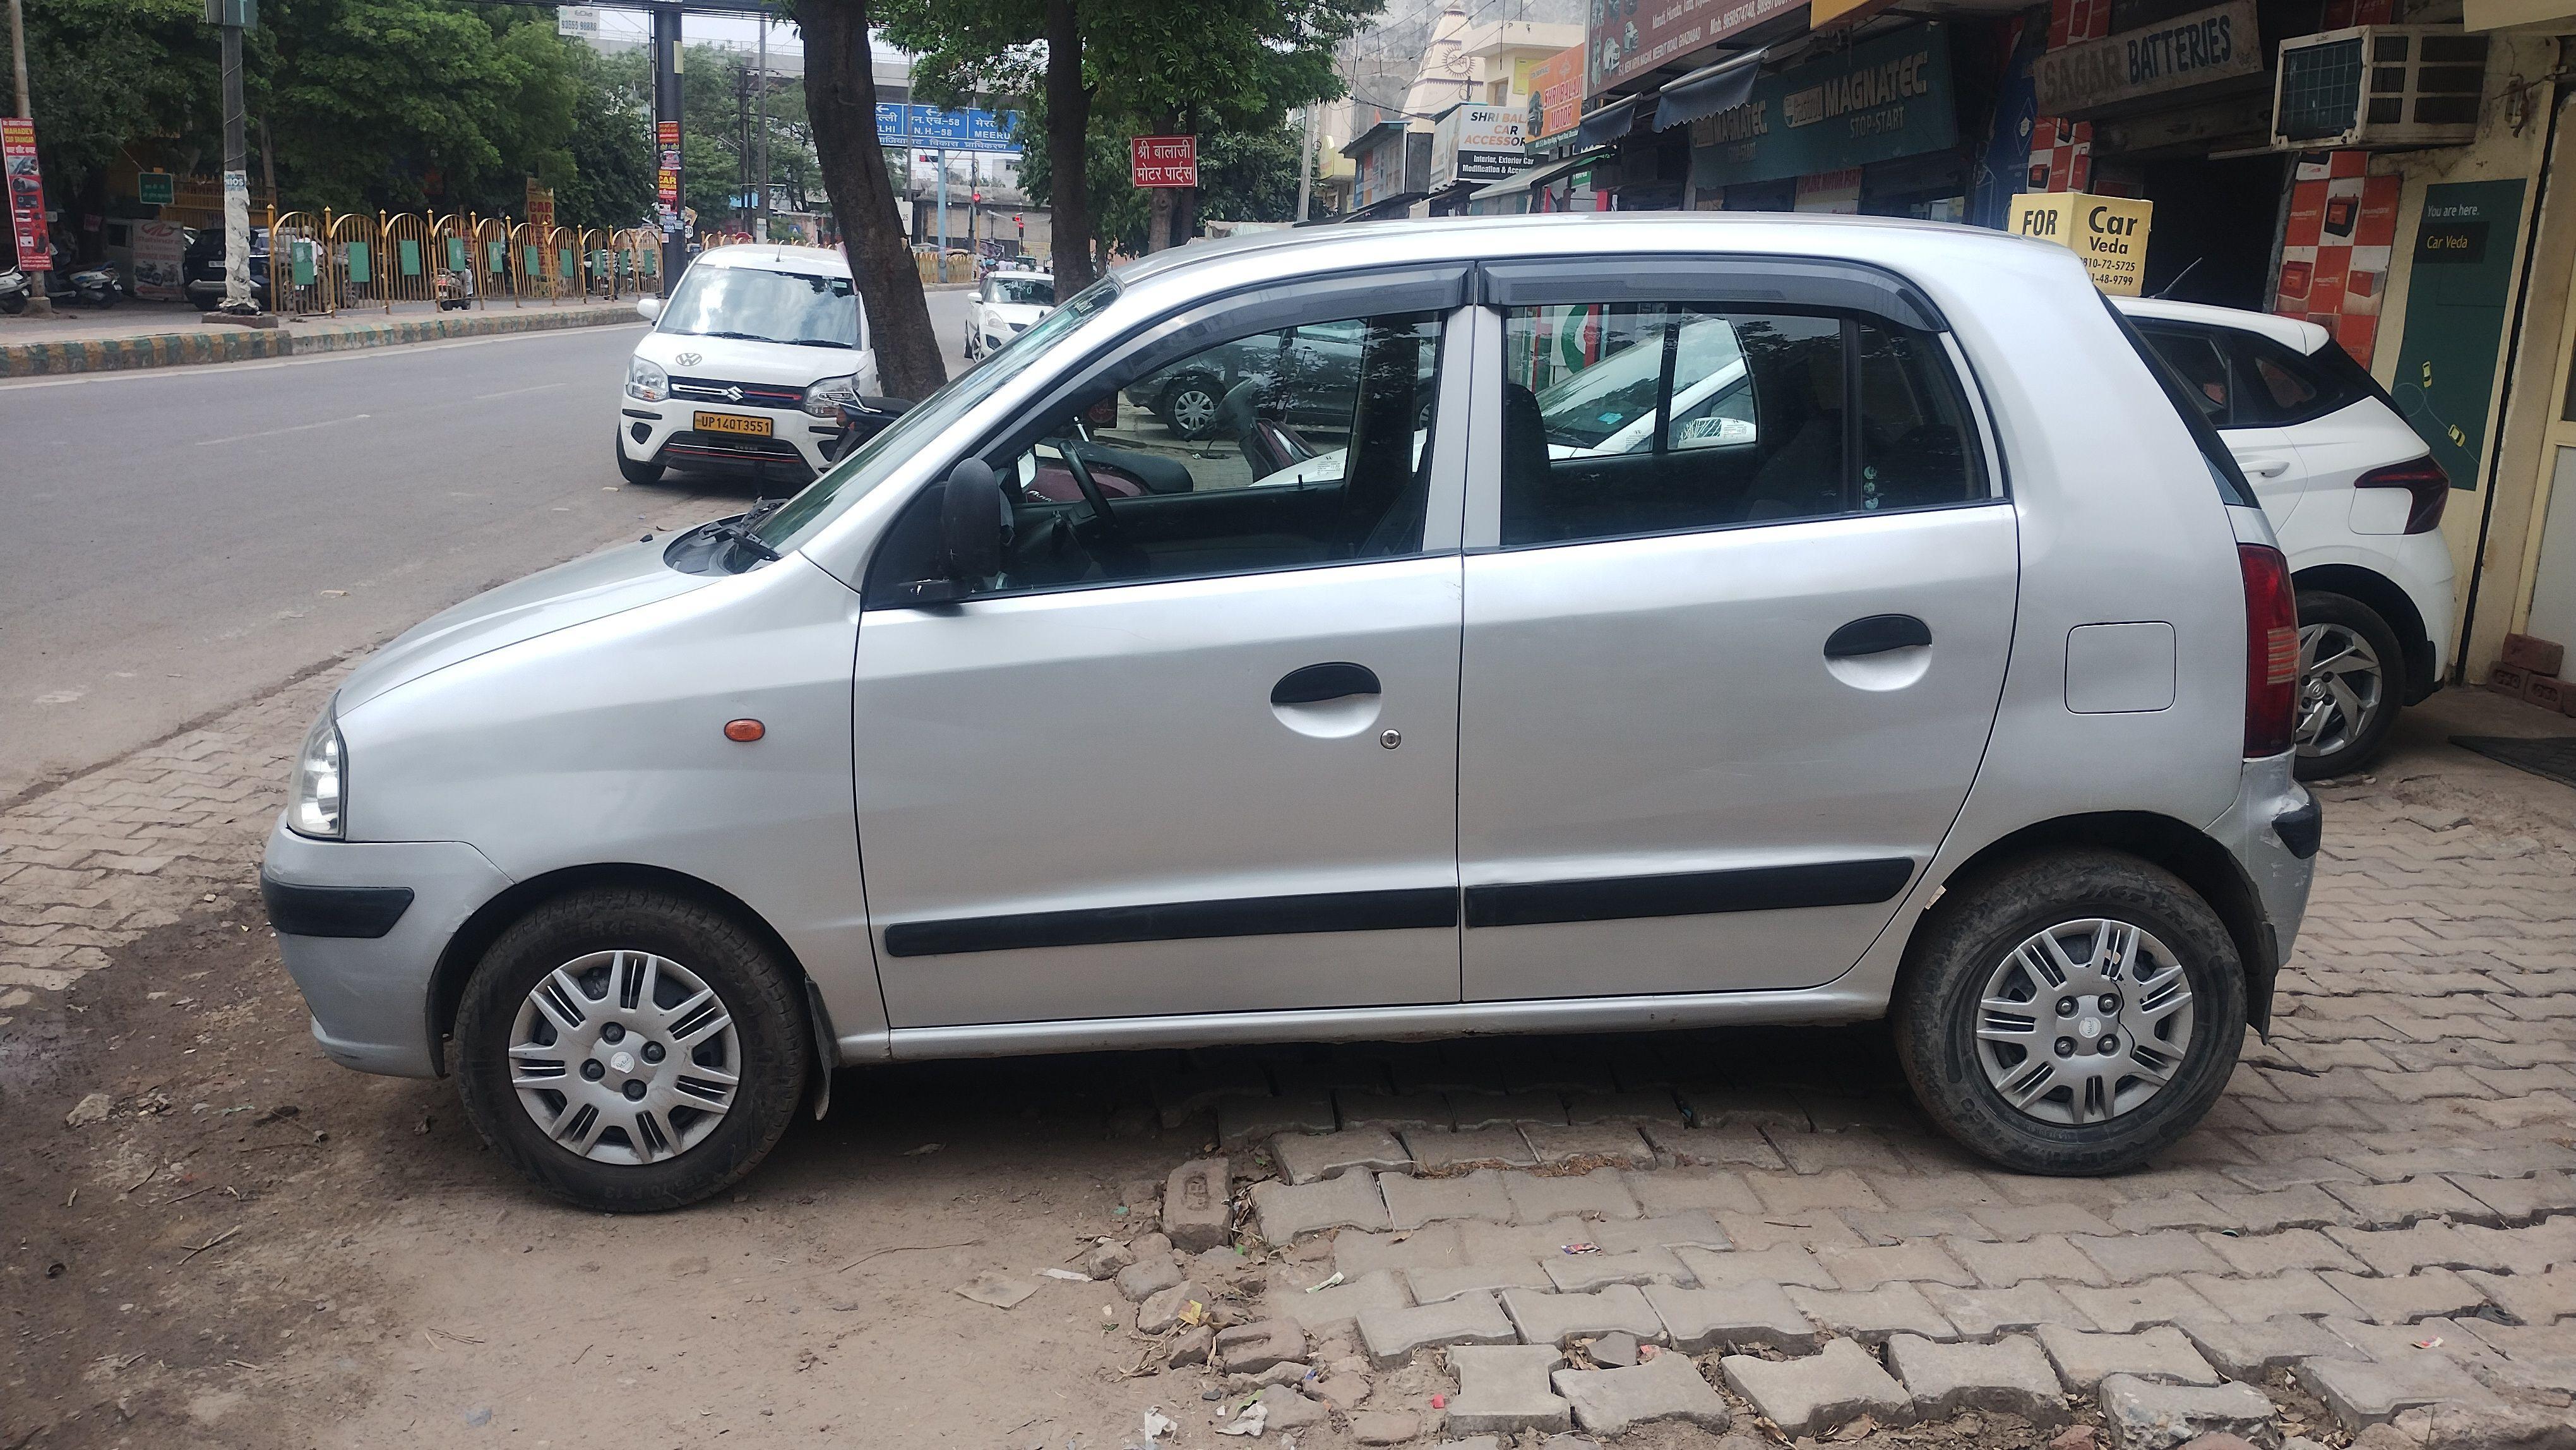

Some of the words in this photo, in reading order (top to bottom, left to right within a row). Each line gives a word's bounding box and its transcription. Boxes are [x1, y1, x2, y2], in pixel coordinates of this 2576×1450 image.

[2044, 44, 2126, 104] SAGAR
[2127, 15, 2231, 85] BATTERIES
[1544, 84, 1559, 110] SHRI
[1559, 74, 1582, 104] BALAJI
[1823, 51, 1928, 118] MAGNATEC
[1470, 112, 1499, 122] SHRI
[1551, 104, 1573, 131] MOTOR
[1850, 105, 1904, 139] STOP-START
[974, 130, 1011, 140] MEERU
[1494, 125, 1518, 135] CAR
[1138, 140, 1150, 160] श्री
[1153, 139, 1191, 159] बालाजी
[1498, 156, 1522, 164] Exterior
[1136, 162, 1162, 181] मोटर
[1462, 164, 1500, 173] Modification
[659, 176, 677, 184] CAR
[529, 201, 552, 213] CAR
[2428, 205, 2442, 217] You
[2443, 207, 2457, 217] are
[2022, 210, 2058, 236] FOR
[2089, 206, 2138, 236] Car
[2089, 236, 2128, 255] Veda
[2426, 236, 2443, 249] Car
[2446, 235, 2468, 249] Veda
[2088, 273, 2134, 286] 1-48-9799
